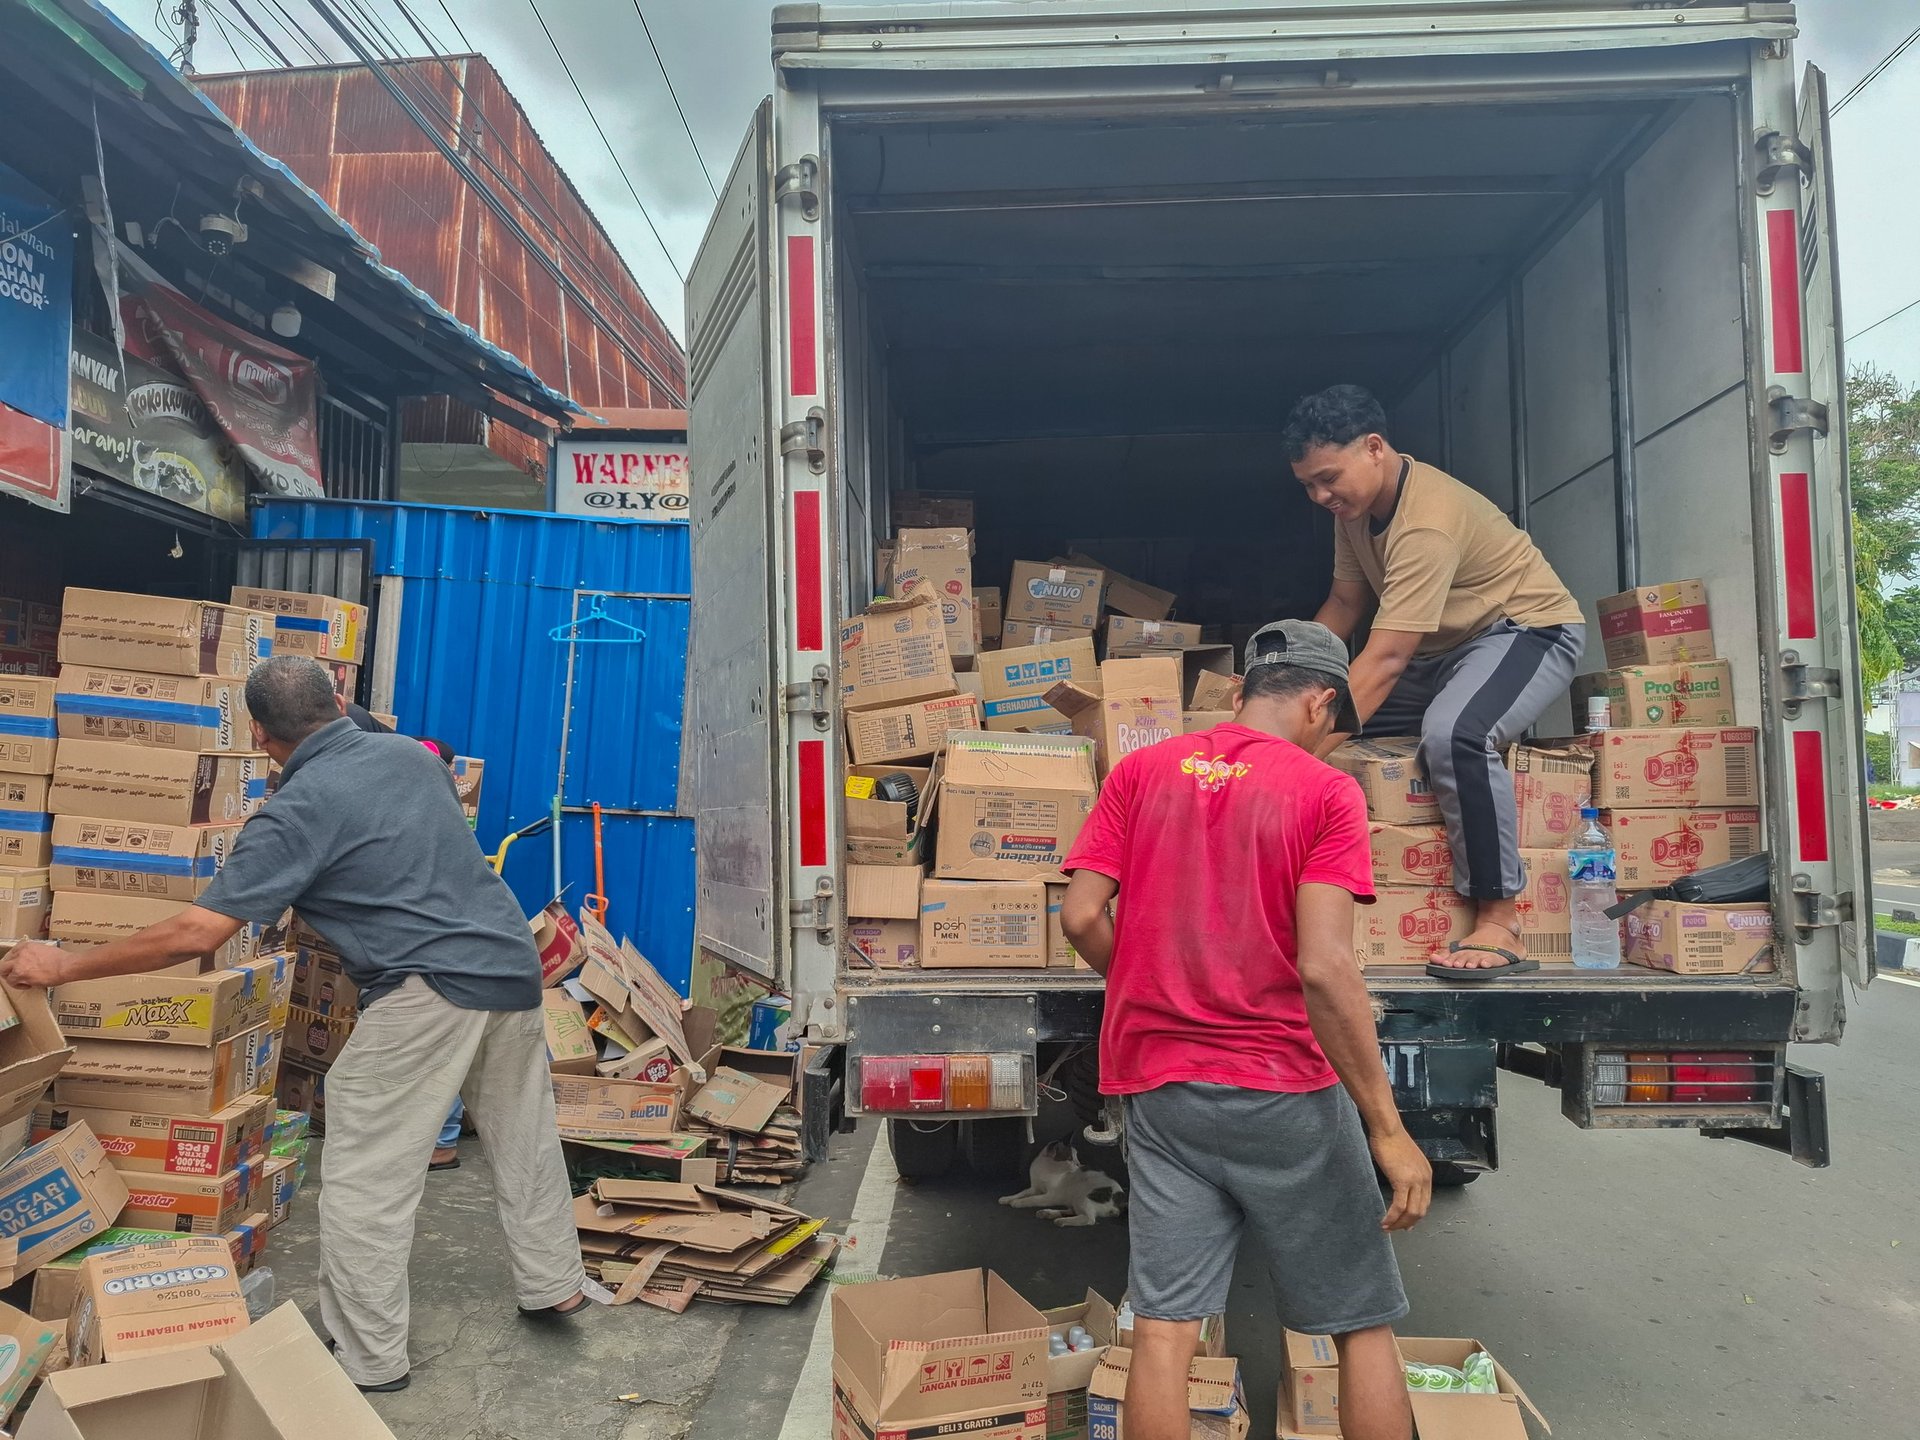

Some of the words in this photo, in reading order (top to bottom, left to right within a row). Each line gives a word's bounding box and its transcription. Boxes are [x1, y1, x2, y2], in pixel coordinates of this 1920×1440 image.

[72, 426, 131, 463] arang!
[584, 491, 689, 510] @LY@
[1043, 585, 1081, 598] NUVO
[842, 622, 864, 642] ama
[1008, 679, 1034, 688] JANGAN
[1036, 673, 1072, 684] DIBANTING
[927, 701, 949, 711] EXTRA
[996, 699, 1041, 713] BERHADIAH
[220, 690, 232, 746] Wafello
[138, 722, 146, 732] 6
[1646, 754, 1697, 782] Daia
[215, 837, 224, 871] fello
[1652, 836, 1703, 863] Daia
[994, 852, 1063, 865] Ciptadent
[1404, 844, 1454, 871] Daia
[129, 873, 137, 884] 6
[933, 916, 967, 937] posh
[1400, 911, 1449, 939] Daia
[1740, 915, 1772, 927] NUVO
[246, 1034, 255, 1086] Wafello
[647, 1062, 666, 1076] Kris
[650, 1069, 667, 1082] Bee
[630, 1105, 668, 1118] mama
[177, 1142, 202, 1151] PCS
[178, 1150, 207, 1158] EXTRA
[175, 1166, 206, 1174] UNTUNG
[0, 1177, 70, 1222] OCARI
[128, 1194, 175, 1208] perstar
[104, 1265, 228, 1295] GORIORIO
[157, 1288, 201, 1301] 080526
[188, 1316, 237, 1330] JANGAN
[117, 1324, 184, 1341] DIBANTING
[919, 1380, 957, 1394] JANGAN
[960, 1372, 1012, 1387] DIBANTING
[1093, 1403, 1114, 1412] SACHET
[1026, 1410, 1046, 1424] 62626
[938, 1423, 956, 1434] BELI
[957, 1422, 963, 1431] 3
[964, 1419, 993, 1430] GRATIS
[1093, 1424, 1115, 1440] 288
